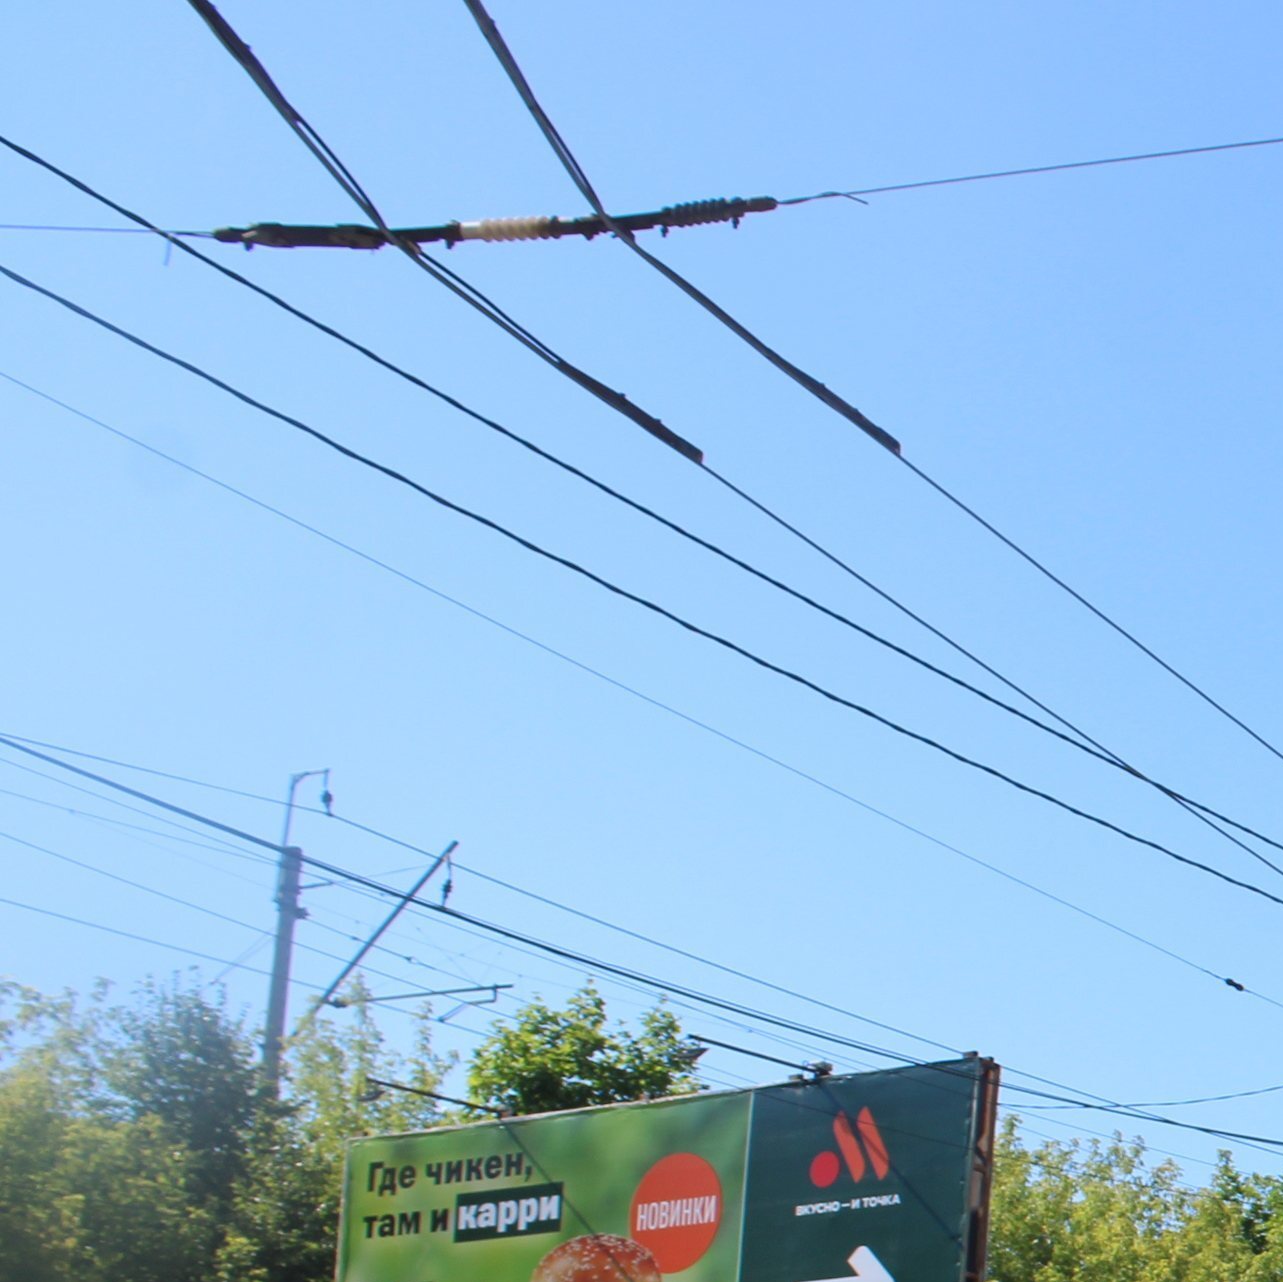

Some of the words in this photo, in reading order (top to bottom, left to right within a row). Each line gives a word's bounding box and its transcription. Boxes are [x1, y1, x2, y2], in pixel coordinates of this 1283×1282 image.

[367, 1161, 417, 1197] Где
[425, 1152, 534, 1185] чикен,
[364, 1211, 421, 1239] там
[430, 1208, 449, 1233] и
[458, 1193, 561, 1233] карри
[636, 1195, 718, 1232] НОВИНКИ
[862, 1194, 901, 1208] ТОЧКА
